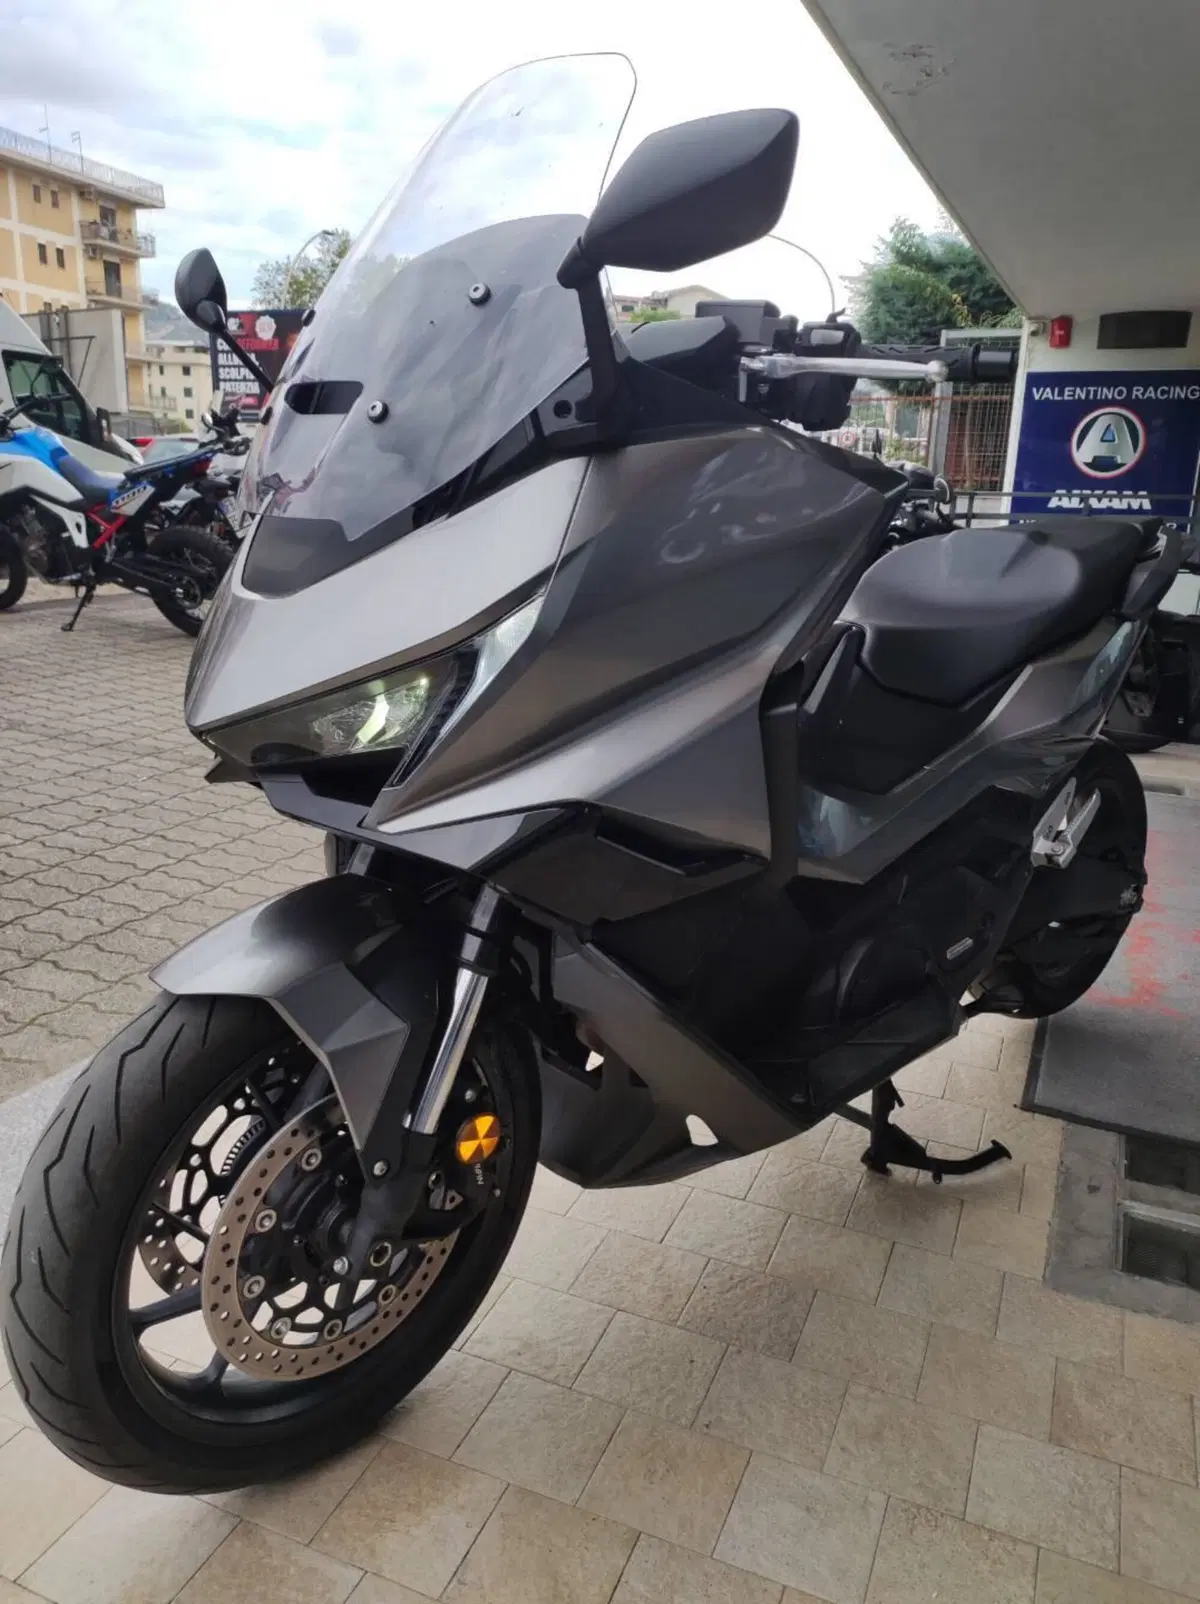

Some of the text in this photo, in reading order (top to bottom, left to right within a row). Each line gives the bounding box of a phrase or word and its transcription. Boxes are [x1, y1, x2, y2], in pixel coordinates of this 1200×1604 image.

[1032, 386, 1200, 400] VALENTINO RACING
[1047, 489, 1152, 510] AIXAM
